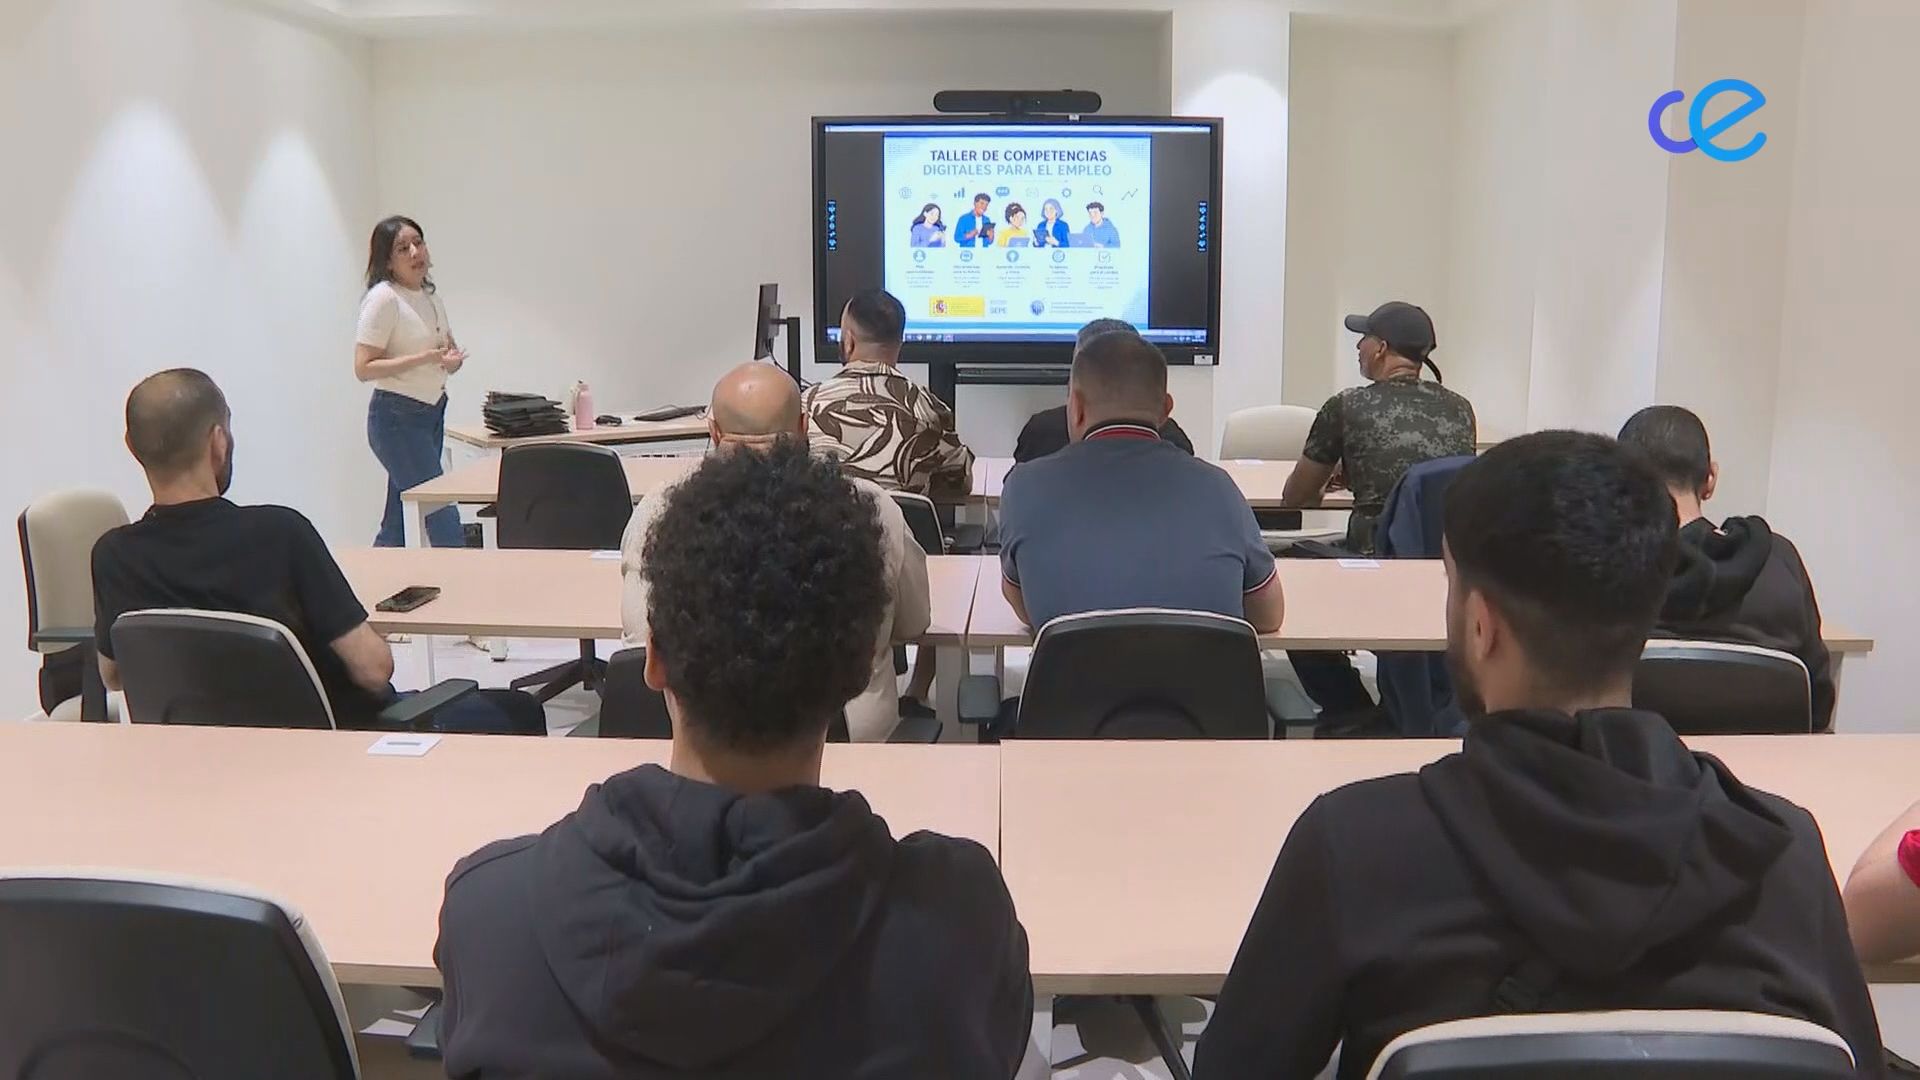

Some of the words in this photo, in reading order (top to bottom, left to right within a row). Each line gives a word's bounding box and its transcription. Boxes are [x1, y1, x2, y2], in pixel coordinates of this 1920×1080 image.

[930, 150, 977, 161] TALLER
[982, 150, 999, 161] DE
[1004, 150, 1107, 162] COMPETENCIAS
[923, 164, 992, 176] DIGITALES
[997, 164, 1033, 176] PARA
[1038, 164, 1053, 176] EL
[1058, 164, 1112, 176] EMPLEO
